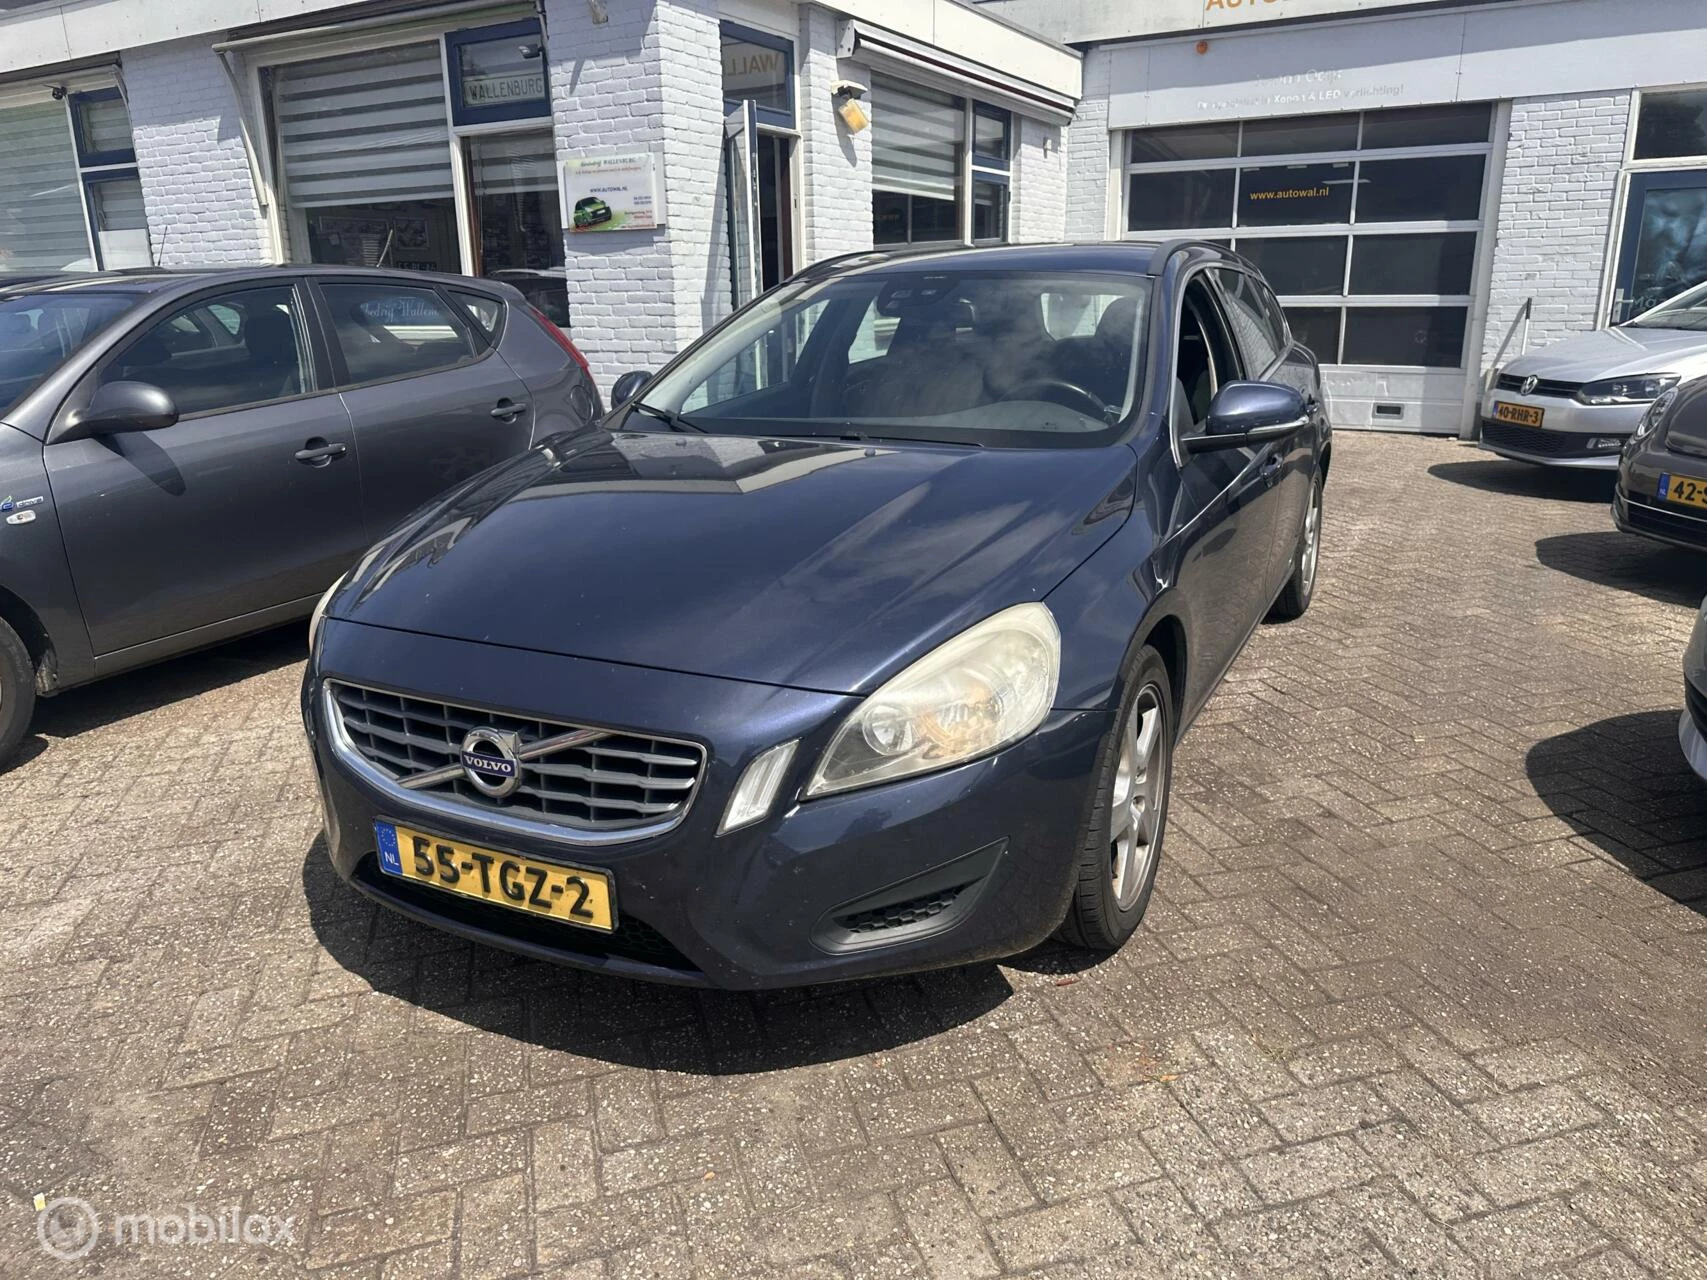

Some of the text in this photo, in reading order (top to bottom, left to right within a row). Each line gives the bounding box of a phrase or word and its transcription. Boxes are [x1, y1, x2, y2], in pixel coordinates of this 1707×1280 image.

[469, 78, 543, 101] WALLENBURG
[1250, 187, 1329, 200] www.autowal.nl
[463, 754, 512, 773] VOLVO
[385, 851, 399, 866] NL
[412, 836, 594, 918] 55-TGZ-2
